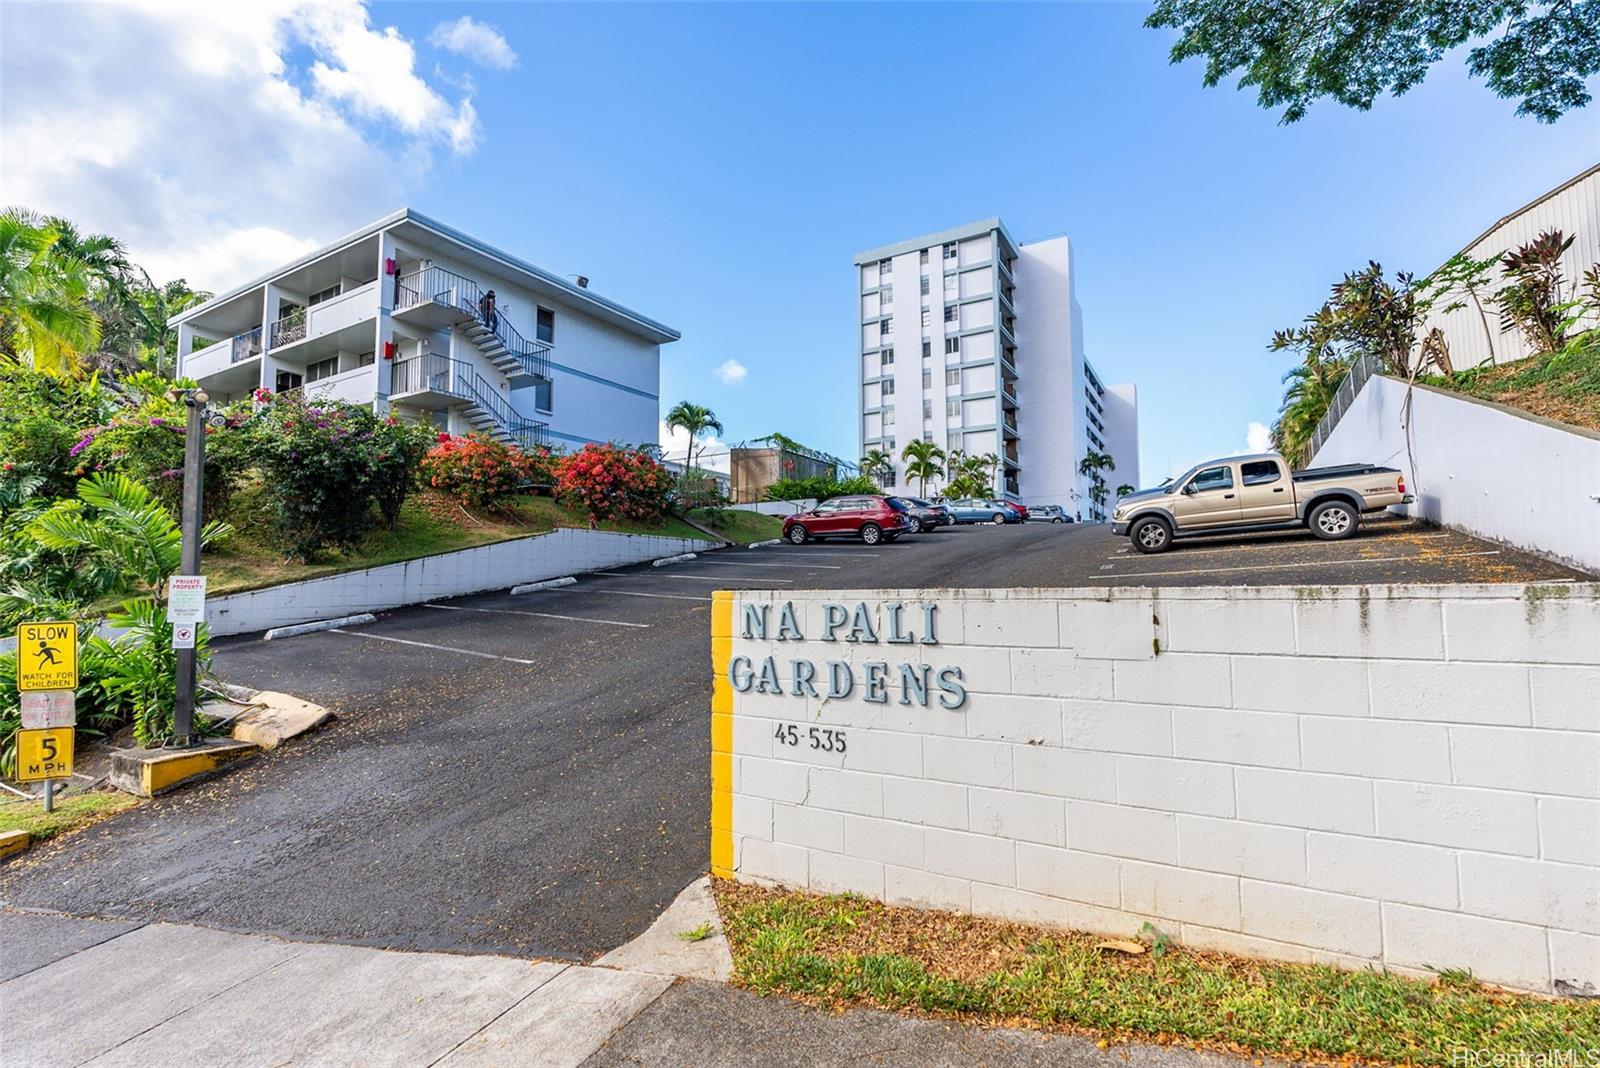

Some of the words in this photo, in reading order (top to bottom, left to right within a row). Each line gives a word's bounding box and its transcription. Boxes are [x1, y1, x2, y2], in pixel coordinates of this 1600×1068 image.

[27, 627, 69, 641] SLOW
[742, 601, 804, 641] NA
[821, 601, 939, 645] PALI
[23, 673, 52, 681] WATCH
[56, 672, 73, 680] FOR
[26, 680, 71, 689] CHILDREN
[728, 654, 968, 710] GARDENS
[42, 738, 57, 762] 5
[774, 723, 847, 753] 45-535
